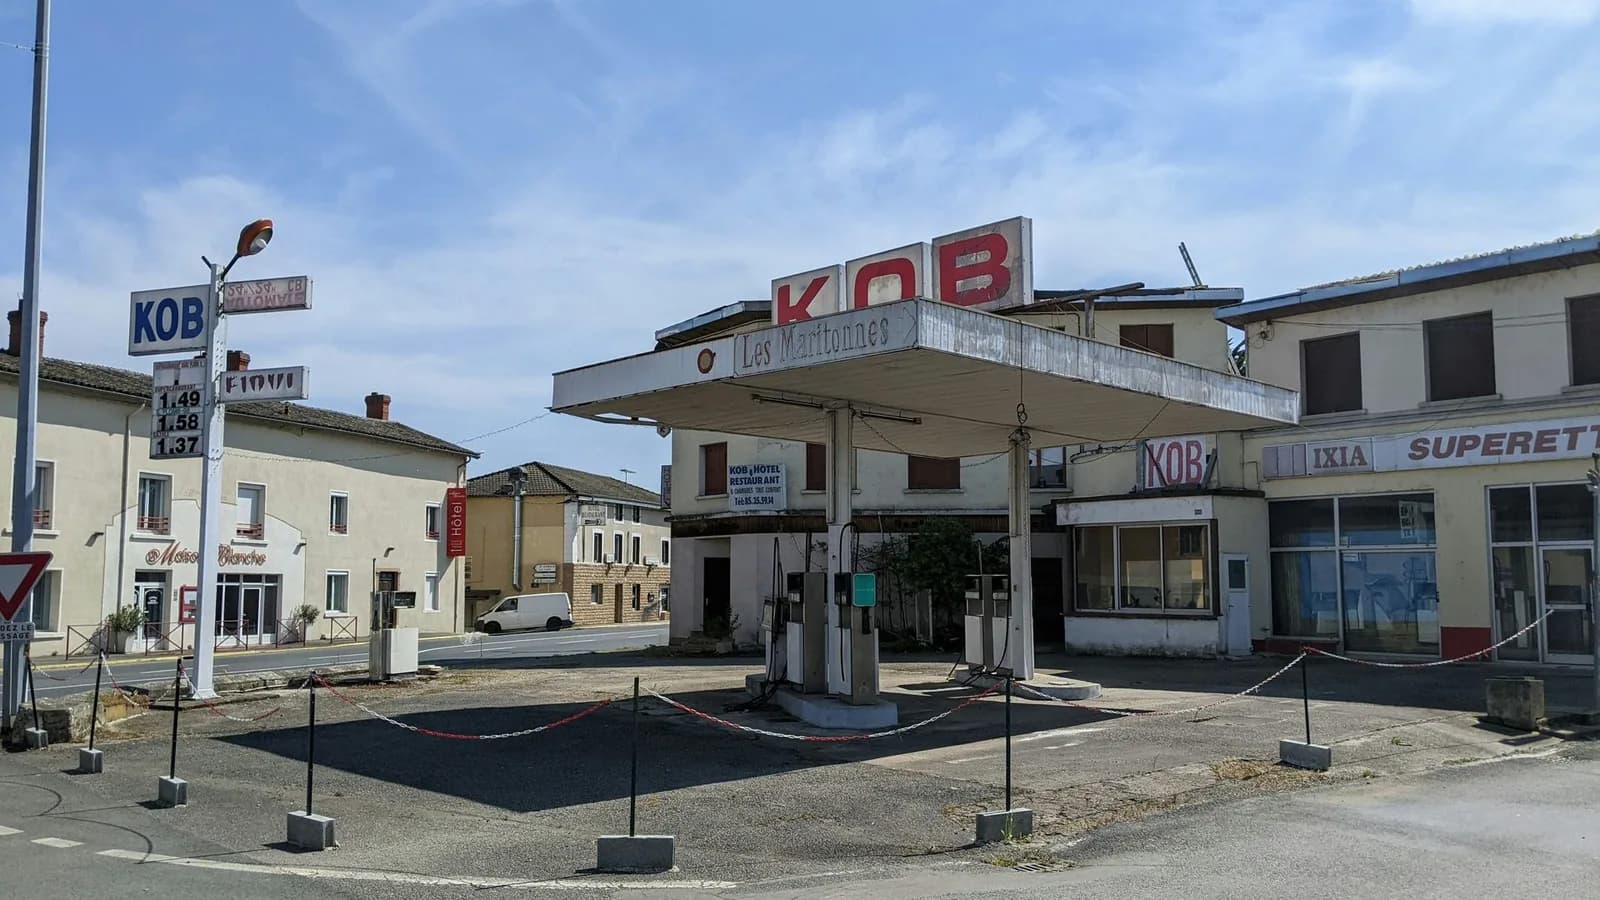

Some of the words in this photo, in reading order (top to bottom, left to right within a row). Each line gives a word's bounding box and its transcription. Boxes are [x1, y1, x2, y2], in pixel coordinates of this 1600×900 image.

[777, 232, 1012, 325] KOB
[133, 297, 204, 344] KOB
[742, 333, 771, 369] Les
[159, 390, 201, 408] 1.49
[158, 413, 199, 431] 1.58
[157, 437, 199, 454] 1.37
[1313, 445, 1368, 469] IXIA
[730, 466, 748, 474] KOB
[753, 464, 781, 473] HOTEL
[1147, 440, 1203, 487] KOB
[730, 476, 780, 486] RESTAURANT
[451, 502, 462, 536] Hôtel
[145, 542, 200, 566] Maiso
